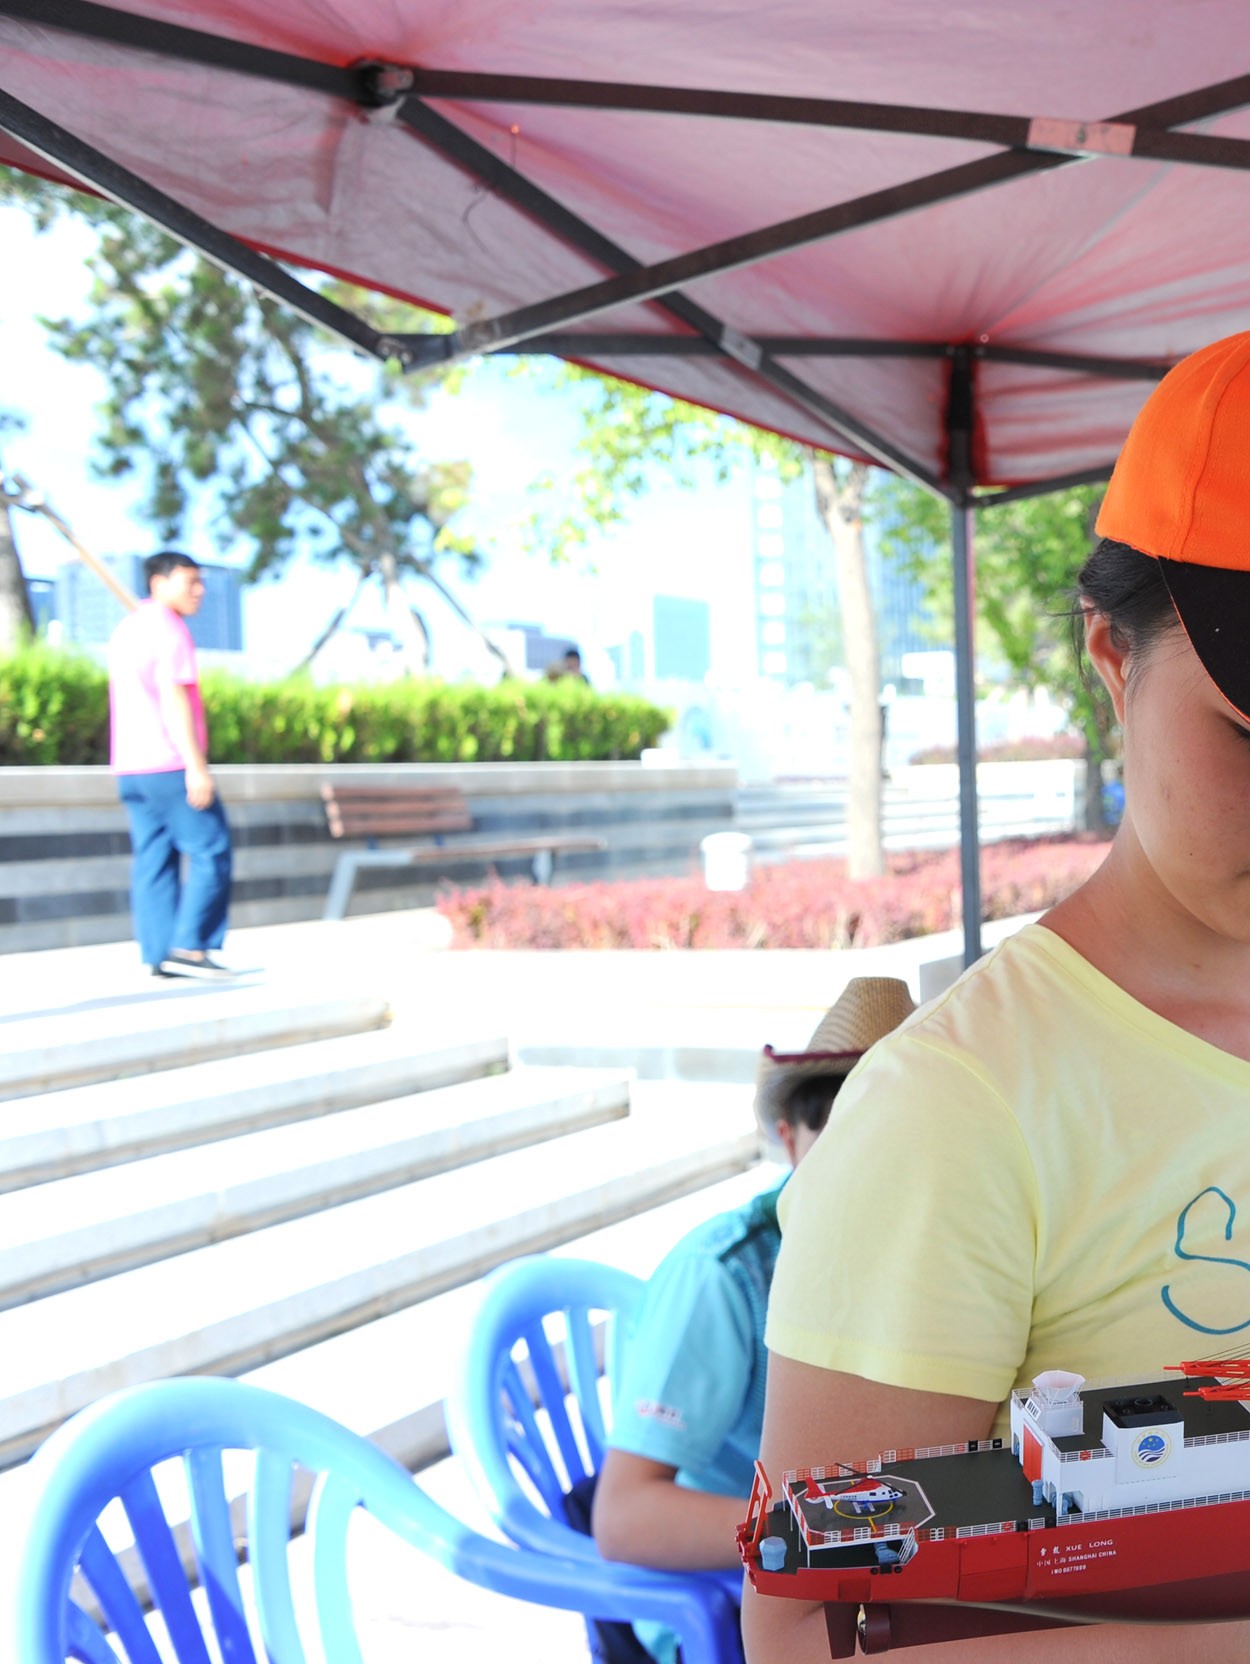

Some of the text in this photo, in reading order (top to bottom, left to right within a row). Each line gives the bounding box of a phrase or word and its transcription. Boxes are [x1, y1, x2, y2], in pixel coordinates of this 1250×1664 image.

[1065, 1544, 1082, 1552] XUE
[1088, 1539, 1114, 1548] LONG
[1068, 1553, 1097, 1562] SHANGHAI
[1098, 1550, 1117, 1558] CHINA
